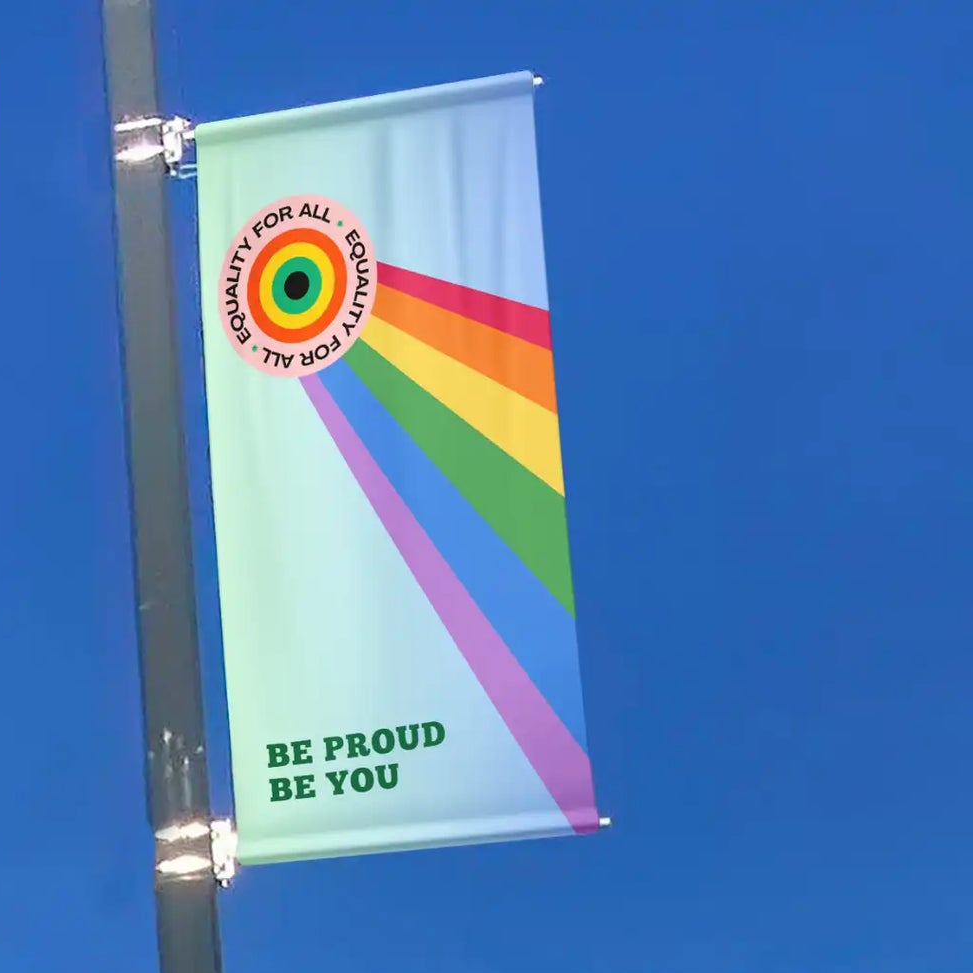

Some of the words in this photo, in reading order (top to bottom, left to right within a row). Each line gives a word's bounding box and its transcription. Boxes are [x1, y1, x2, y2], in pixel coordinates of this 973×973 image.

[225, 236, 252, 345] EQUALITY
[251, 205, 294, 238] FOR
[298, 202, 331, 224] ALL
[341, 229, 370, 337] EQUALITY
[262, 347, 295, 369] ALL
[299, 334, 342, 366] FOR
[266, 739, 313, 769] BE
[323, 720, 446, 762] PROUD
[269, 774, 316, 802] BE
[325, 763, 399, 796] YOU
